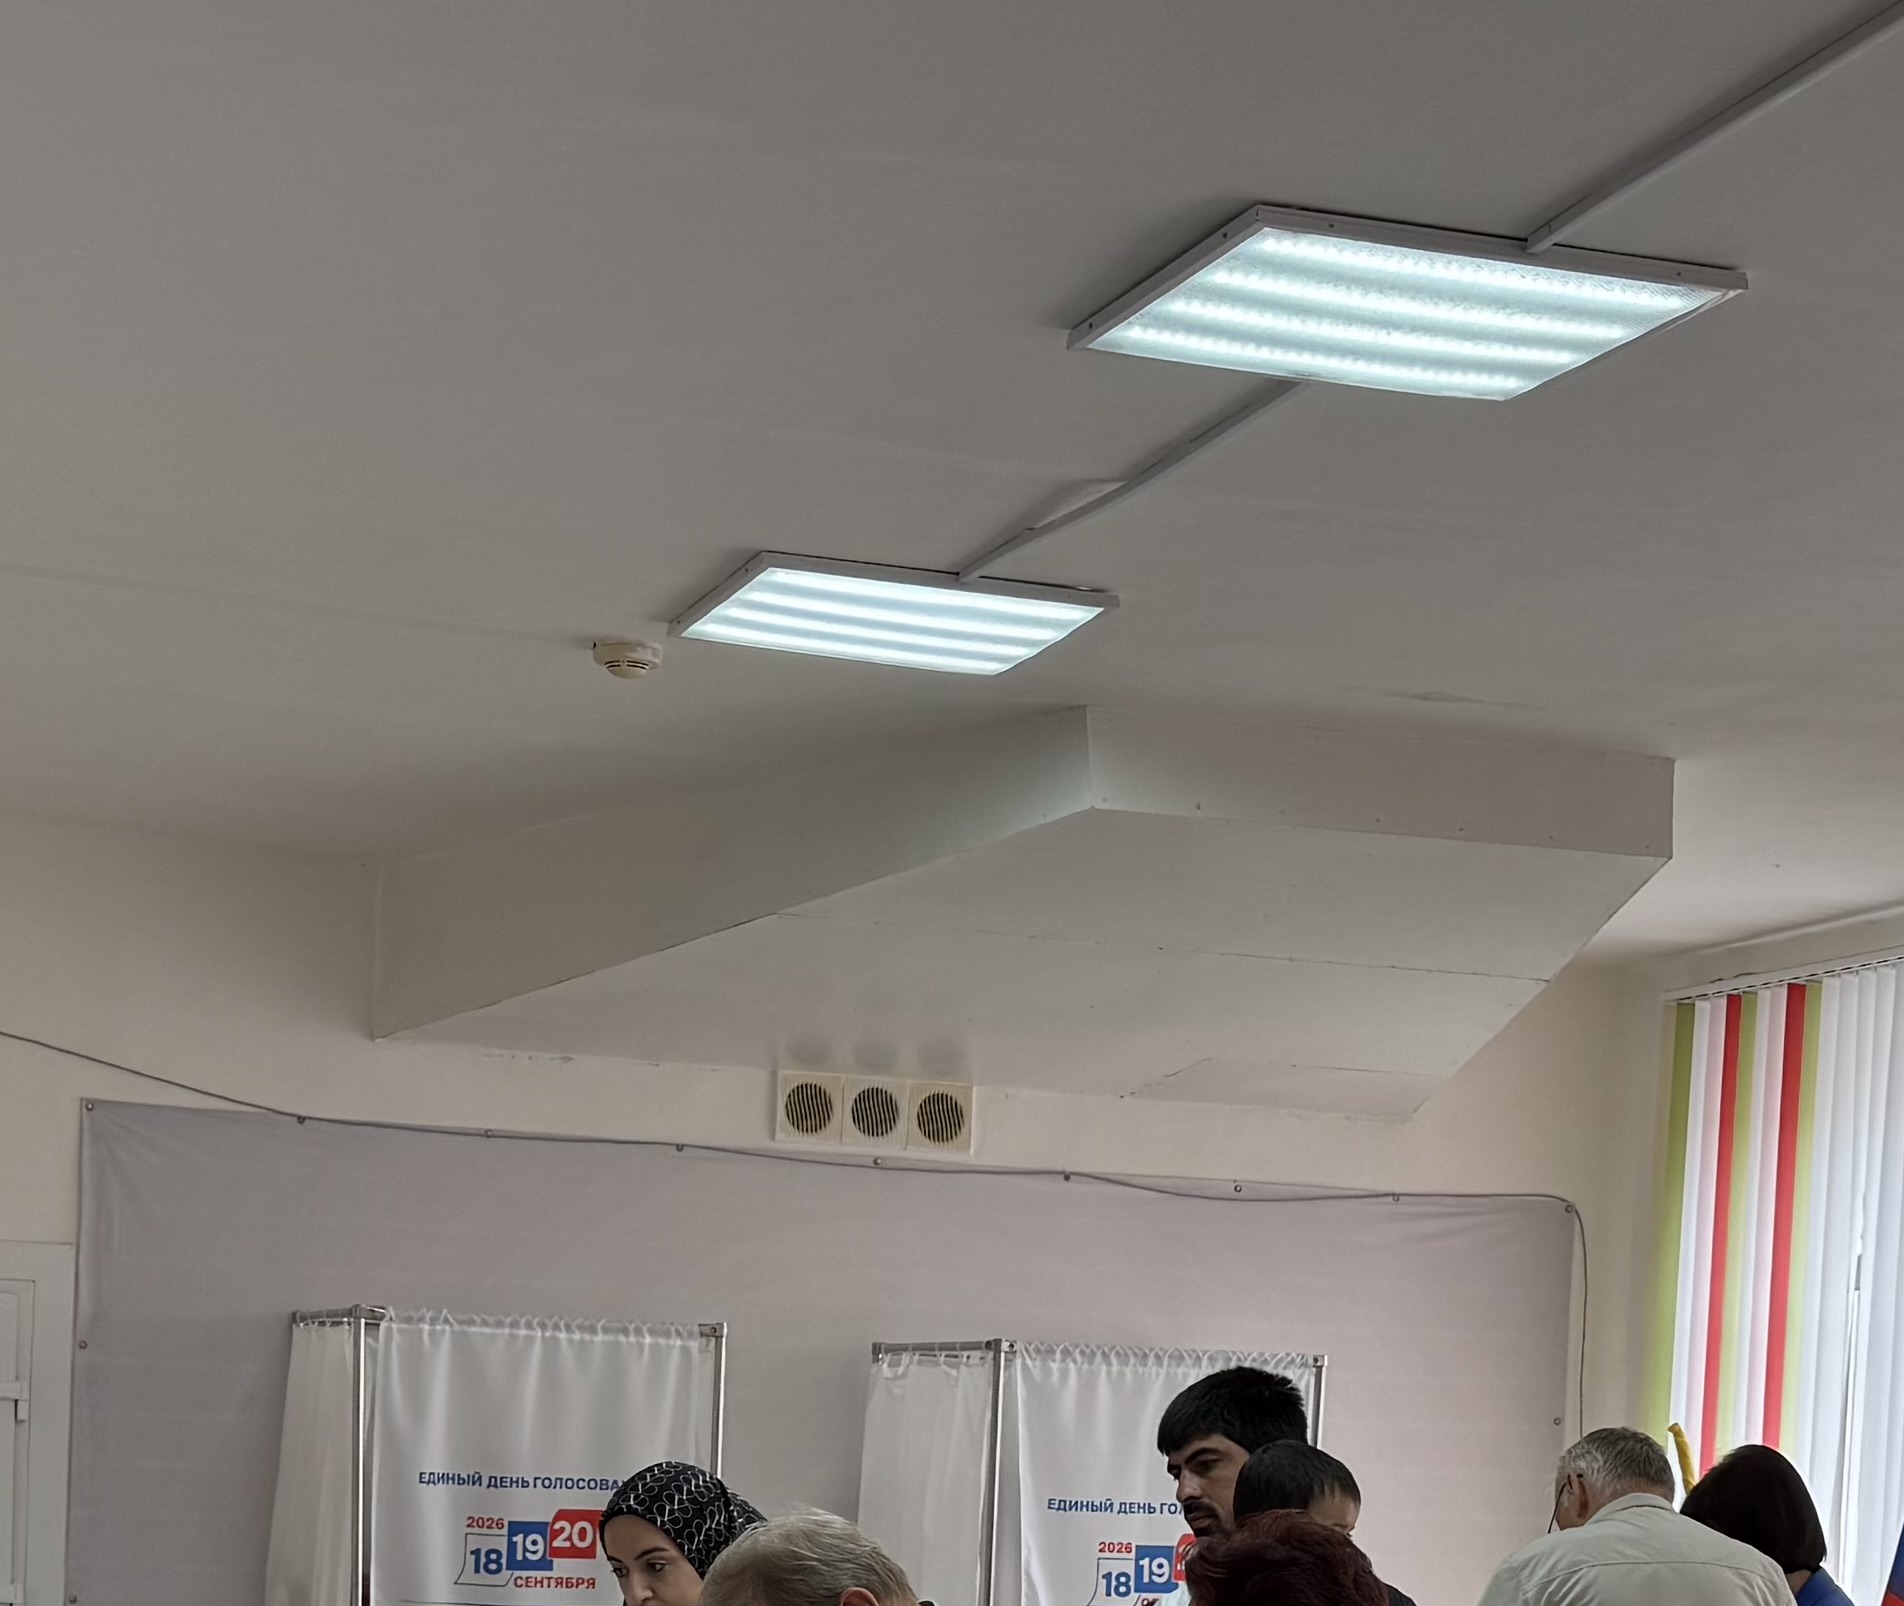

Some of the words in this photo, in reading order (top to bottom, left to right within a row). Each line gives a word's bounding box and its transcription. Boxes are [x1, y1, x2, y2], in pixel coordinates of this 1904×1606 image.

[418, 1471, 483, 1487] ЕДИНЫЙ
[487, 1476, 530, 1489] ДЕНЬ
[533, 1477, 621, 1491] ГОЛОСОВА
[1047, 1498, 1114, 1513] ЕДИНЫЙ
[1117, 1502, 1156, 1515] ДЕНЬ
[466, 1516, 505, 1529] 2026
[470, 1548, 504, 1575] 18
[512, 1533, 545, 1561] 19
[552, 1520, 594, 1548] 20
[1098, 1541, 1133, 1553] 2026
[513, 1576, 596, 1589] СЕНТЯБРЯ
[1101, 1571, 1131, 1597] 18
[1139, 1557, 1170, 1583] 19
